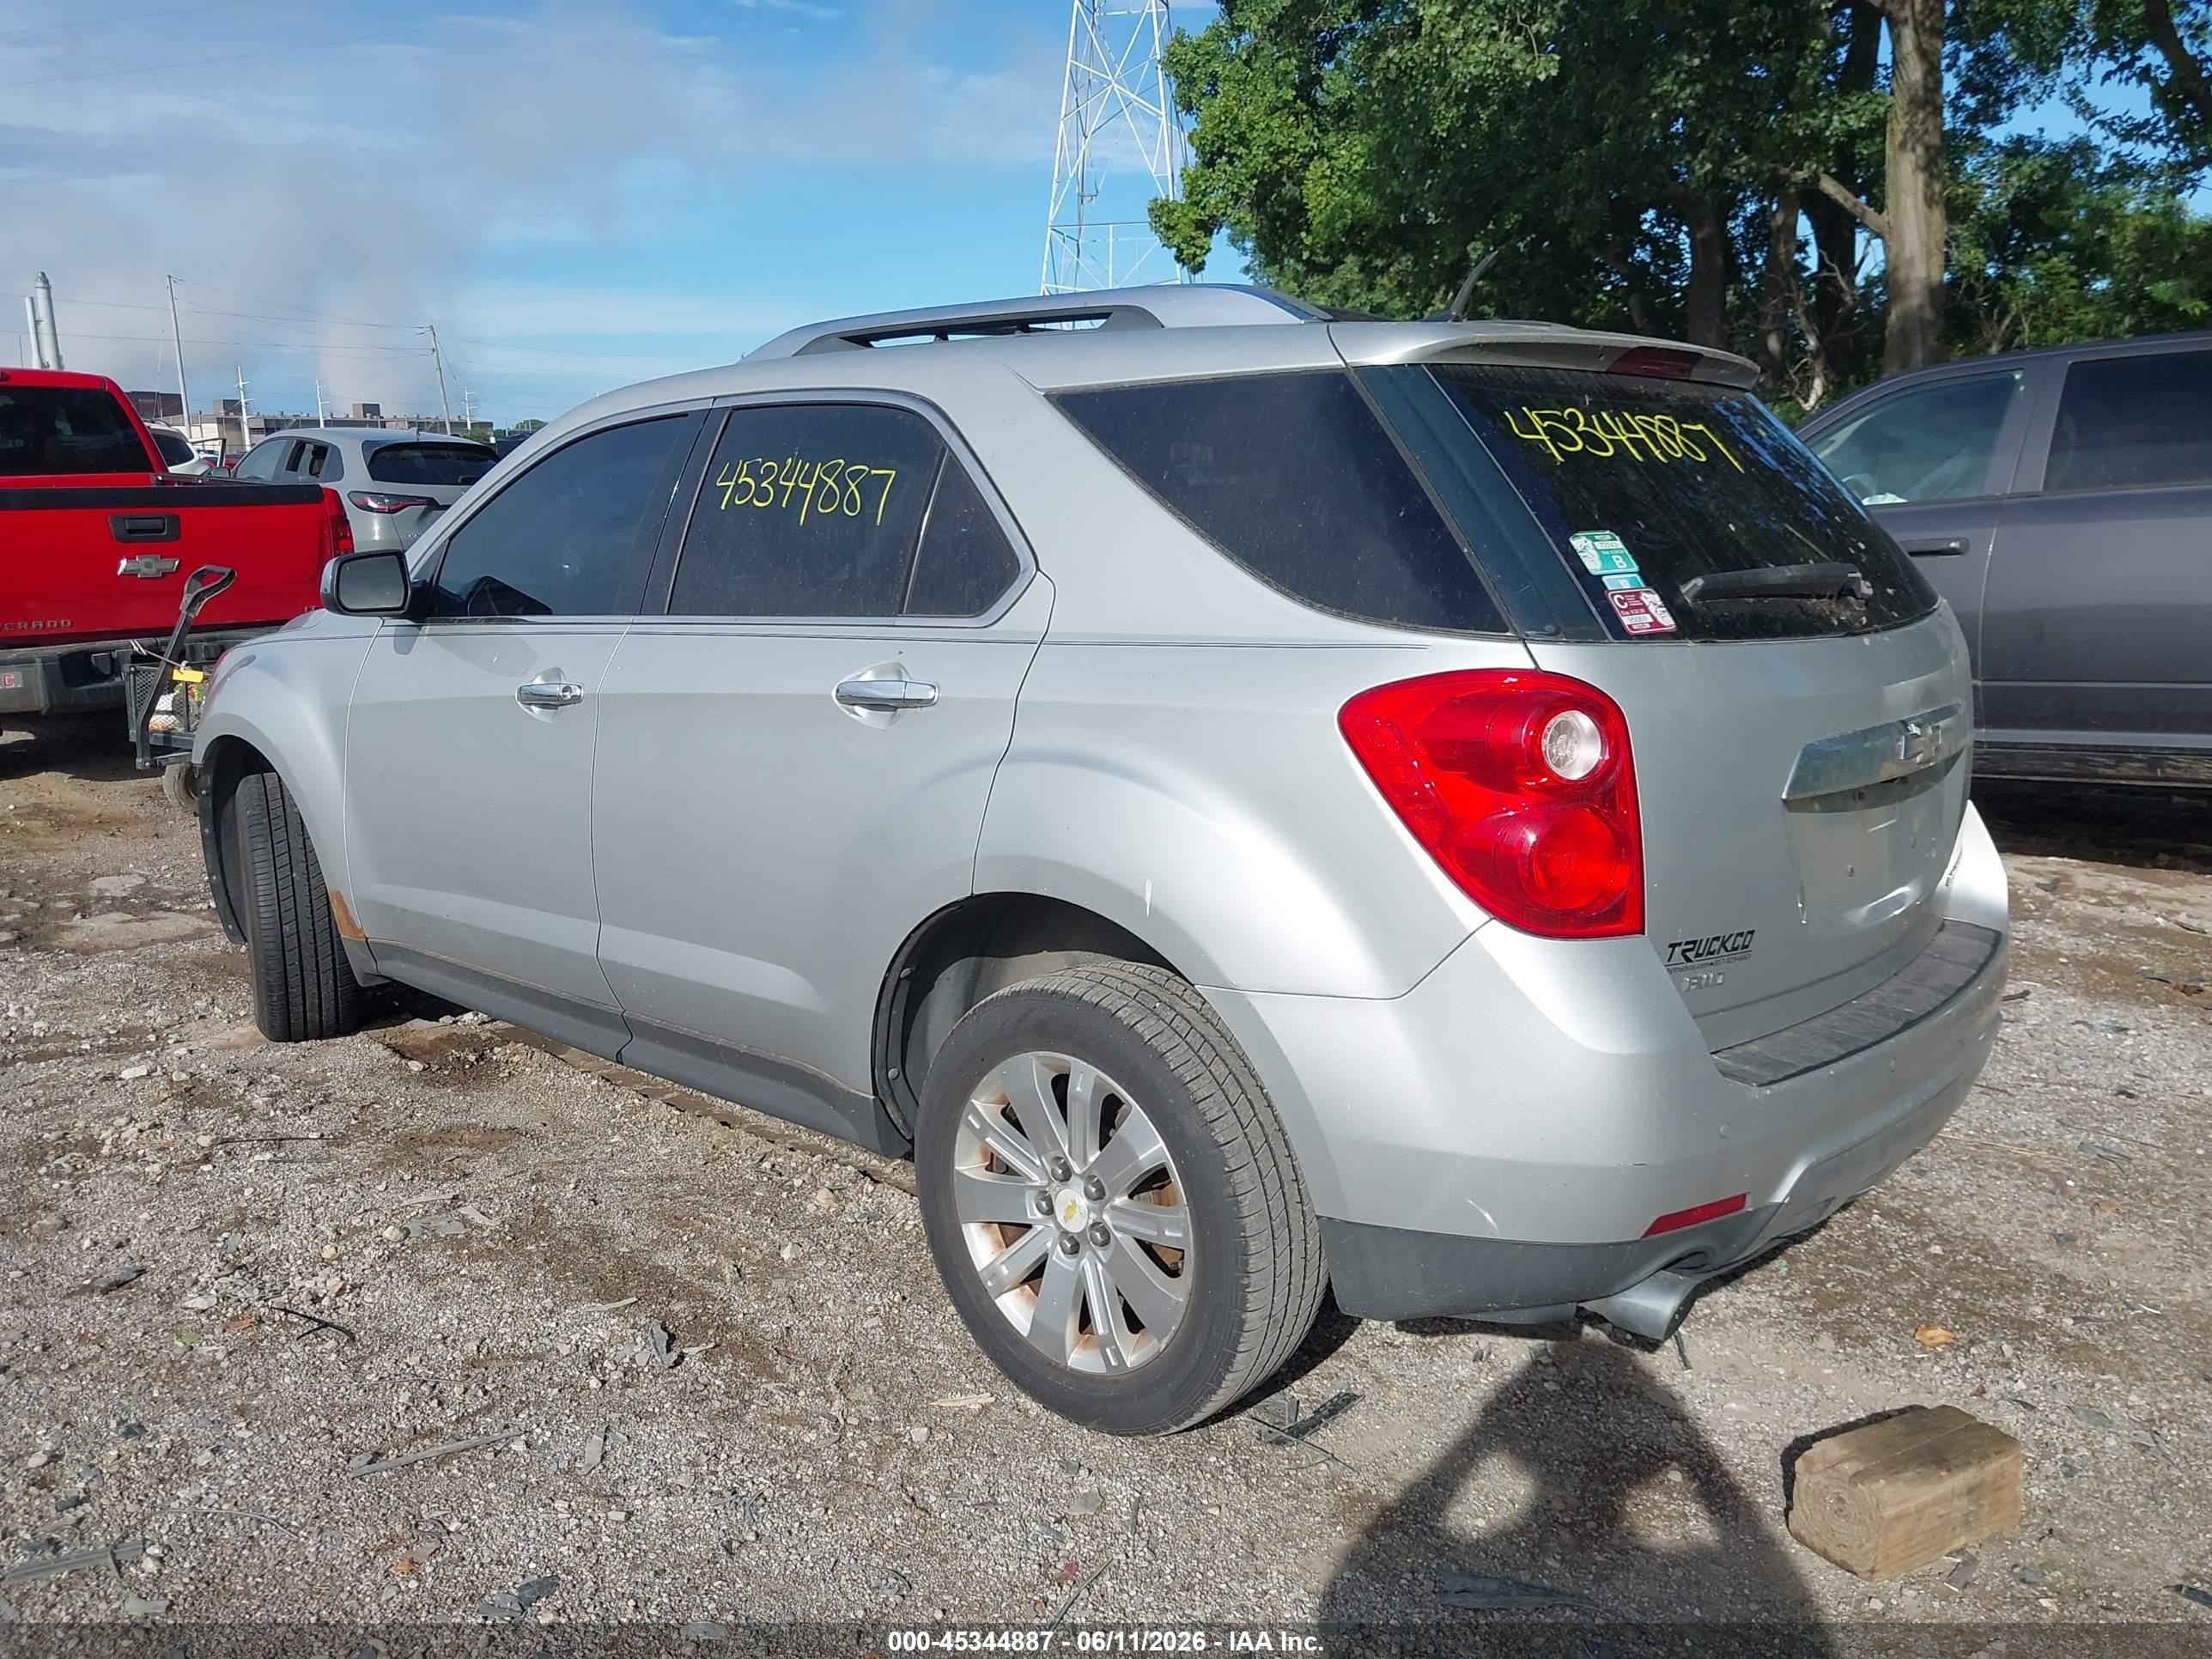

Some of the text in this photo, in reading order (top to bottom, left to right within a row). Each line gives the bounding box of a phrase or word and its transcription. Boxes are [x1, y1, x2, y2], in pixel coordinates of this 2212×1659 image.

[1504, 406, 1745, 474] 45344887
[715, 457, 896, 526] 45344887
[1612, 555, 1627, 568] B
[1613, 594, 1628, 609] C
[0, 619, 71, 630] ERADO
[1668, 930, 1755, 963] TRUCKCO
